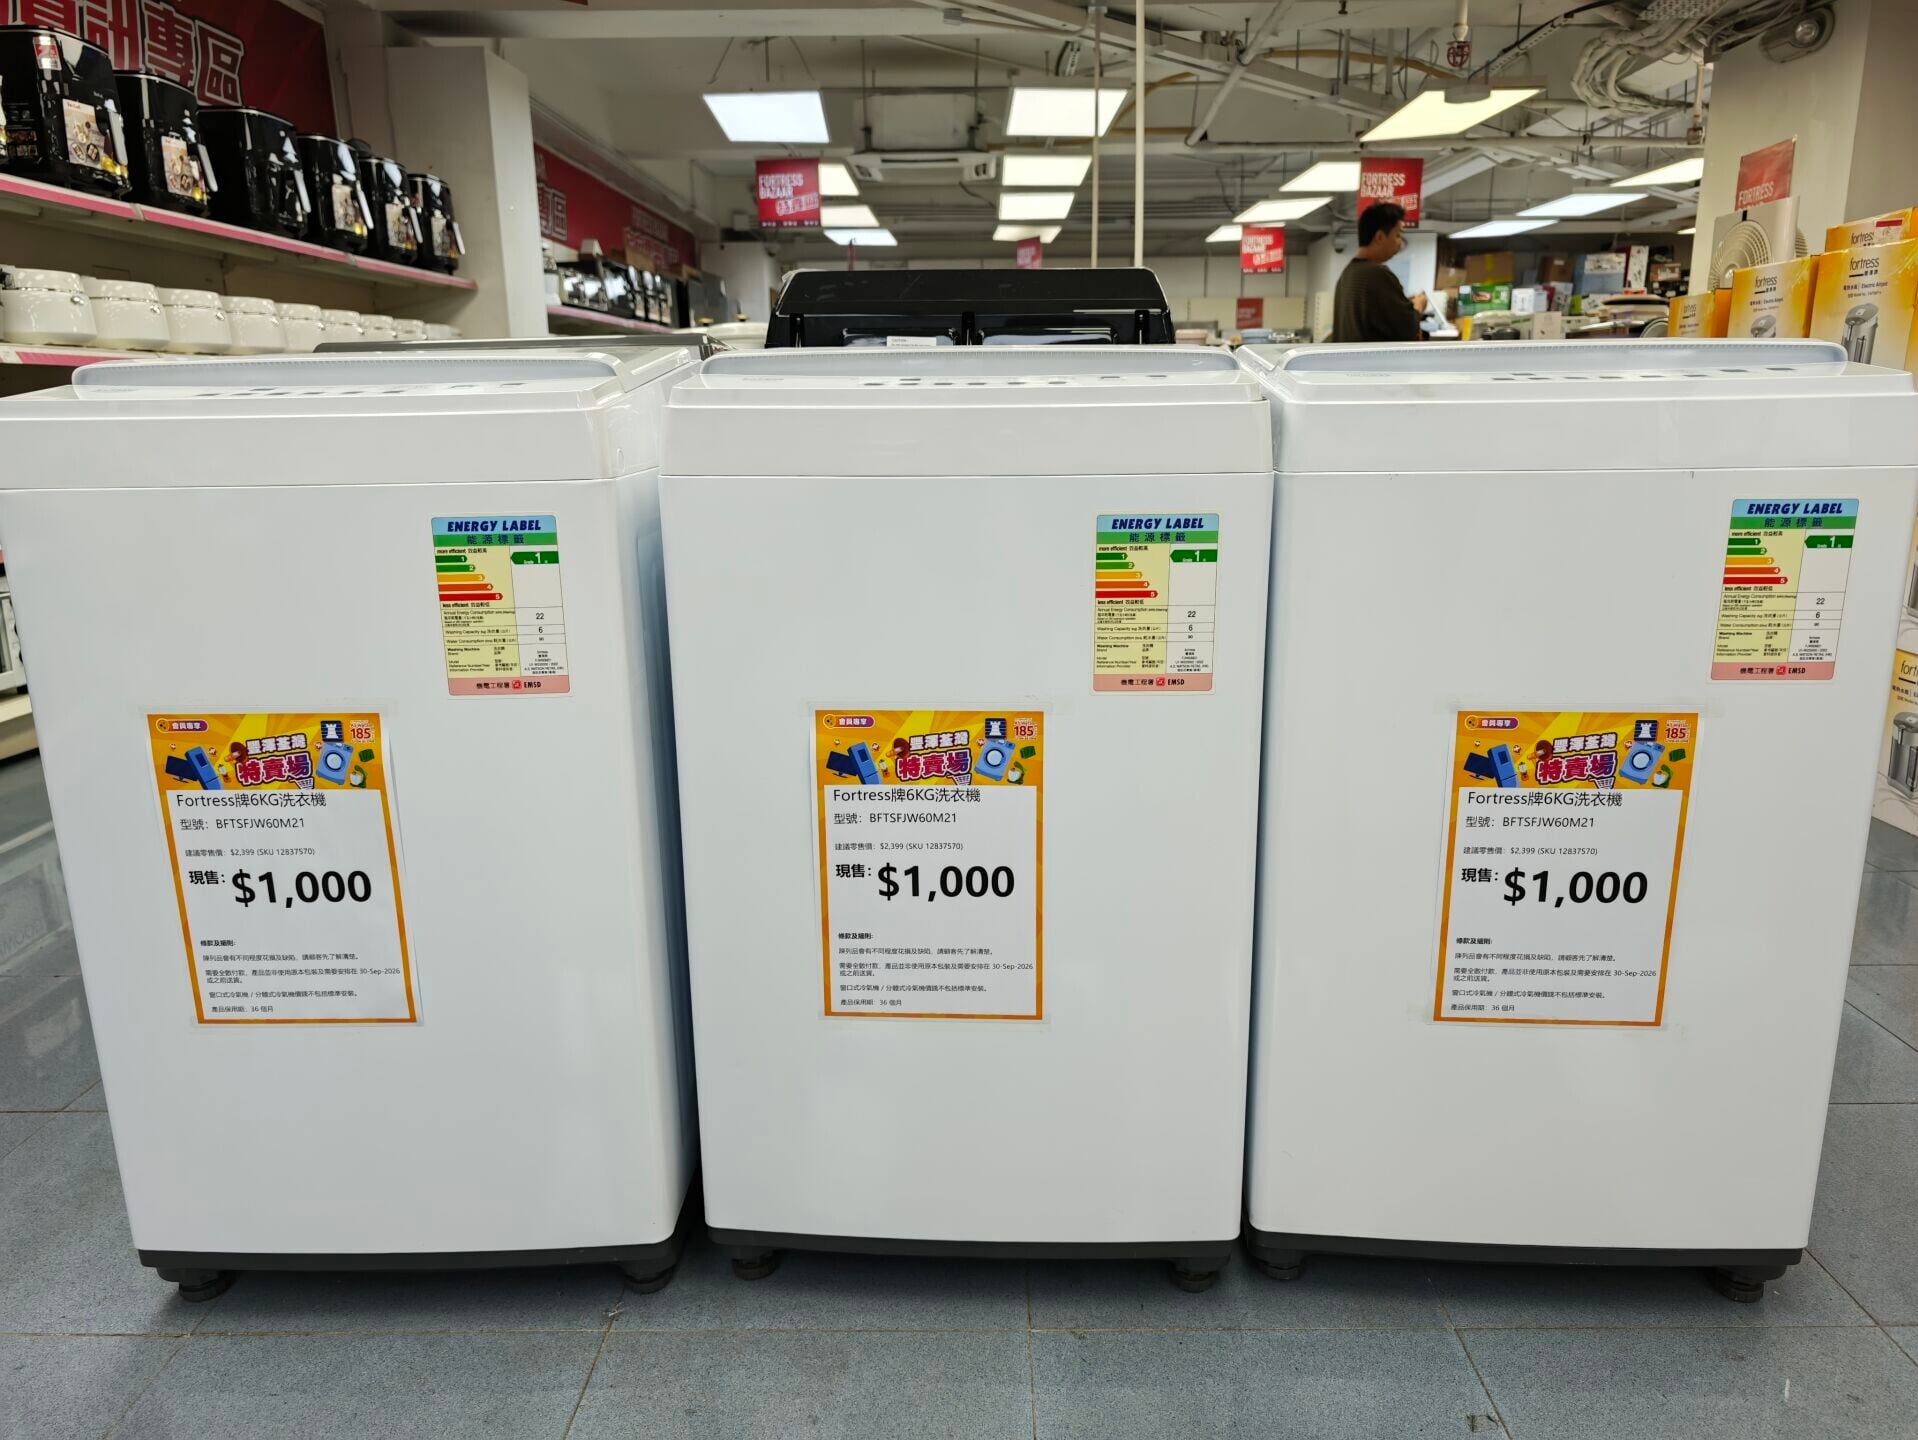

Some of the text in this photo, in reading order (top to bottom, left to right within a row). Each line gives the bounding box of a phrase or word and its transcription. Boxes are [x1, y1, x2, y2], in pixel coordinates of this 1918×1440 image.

[1361, 172, 1405, 187] FORTRESS
[1738, 182, 1775, 207] FORTRESS
[1849, 257, 1880, 271] fortress
[1755, 275, 1778, 289] fortress
[1747, 503, 1842, 514] ENERGY LABEL
[448, 520, 542, 532] ENERGY LABEL
[1112, 518, 1204, 530] ENERGY LABEL
[1829, 536, 1836, 547] 1
[536, 552, 541, 564] 1
[1194, 550, 1200, 562] 1
[350, 728, 372, 739] 185
[1013, 726, 1034, 736] 185
[1665, 728, 1686, 738] 185
[237, 755, 312, 785] 特賣場
[898, 750, 970, 780] 特賣場
[1538, 753, 1615, 784] 特賣場
[176, 792, 327, 808] Fortress牌6KG洗衣機
[833, 788, 981, 803] Fortress牌6KG洗衣機
[1468, 791, 1623, 807] Fortress牌6KG洗衣機
[216, 818, 305, 829] BFTSFJW60M21
[869, 813, 957, 823] BFTSFJW60M21
[1502, 817, 1595, 828] BFTSFJW60M21
[230, 848, 255, 857] $2,399
[256, 848, 274, 856] (SKU
[276, 848, 315, 856] 12837570)
[880, 842, 904, 851] $2,399
[905, 842, 923, 850] (SKU
[926, 842, 964, 850] 12837570)
[1510, 847, 1536, 856] $2,399
[1537, 847, 1556, 856] (SKU
[1558, 848, 1598, 856] 12837570)
[878, 862, 1015, 902] $1,000
[1503, 867, 1648, 908] $1,000
[231, 869, 372, 908] $1,000
[359, 968, 401, 976] 30-Sep-2026
